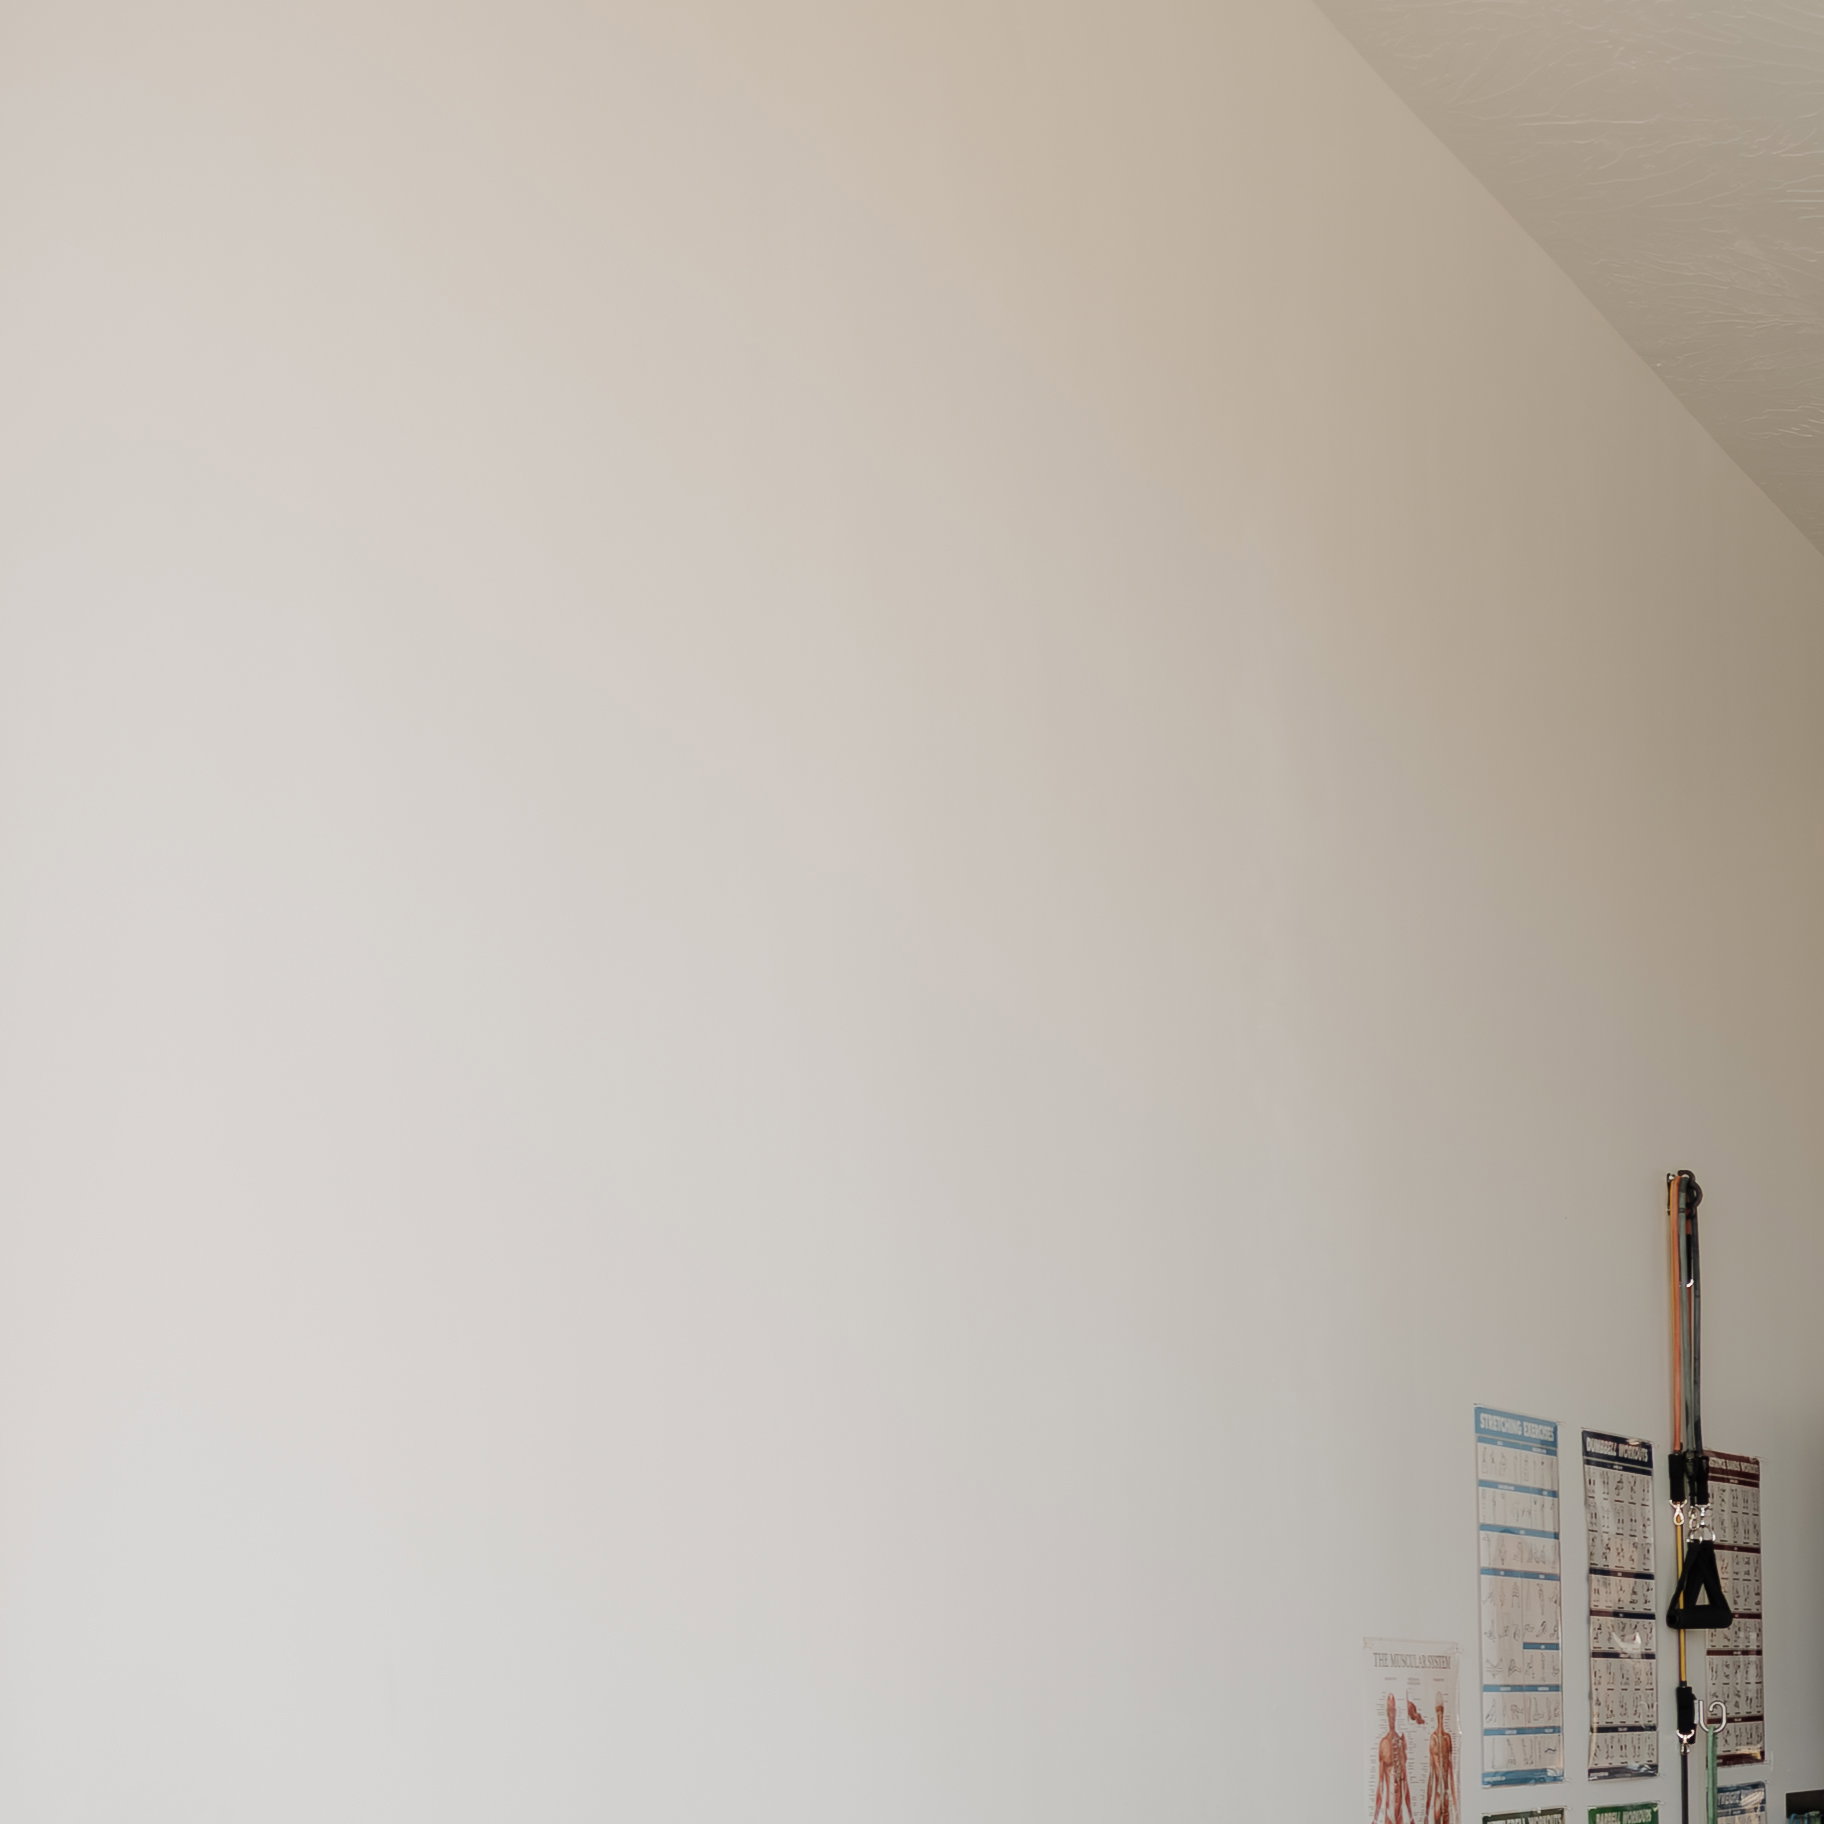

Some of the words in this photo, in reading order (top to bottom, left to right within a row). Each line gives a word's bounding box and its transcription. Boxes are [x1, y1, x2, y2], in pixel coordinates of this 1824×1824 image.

[1586, 1436, 1617, 1456] DUMBBELL
[1618, 1443, 1648, 1462] WORKOUTS
[1373, 1652, 1390, 1668] THE
[1390, 1653, 1427, 1668] MUSCULAR
[1427, 1654, 1452, 1669] SYSTEM
